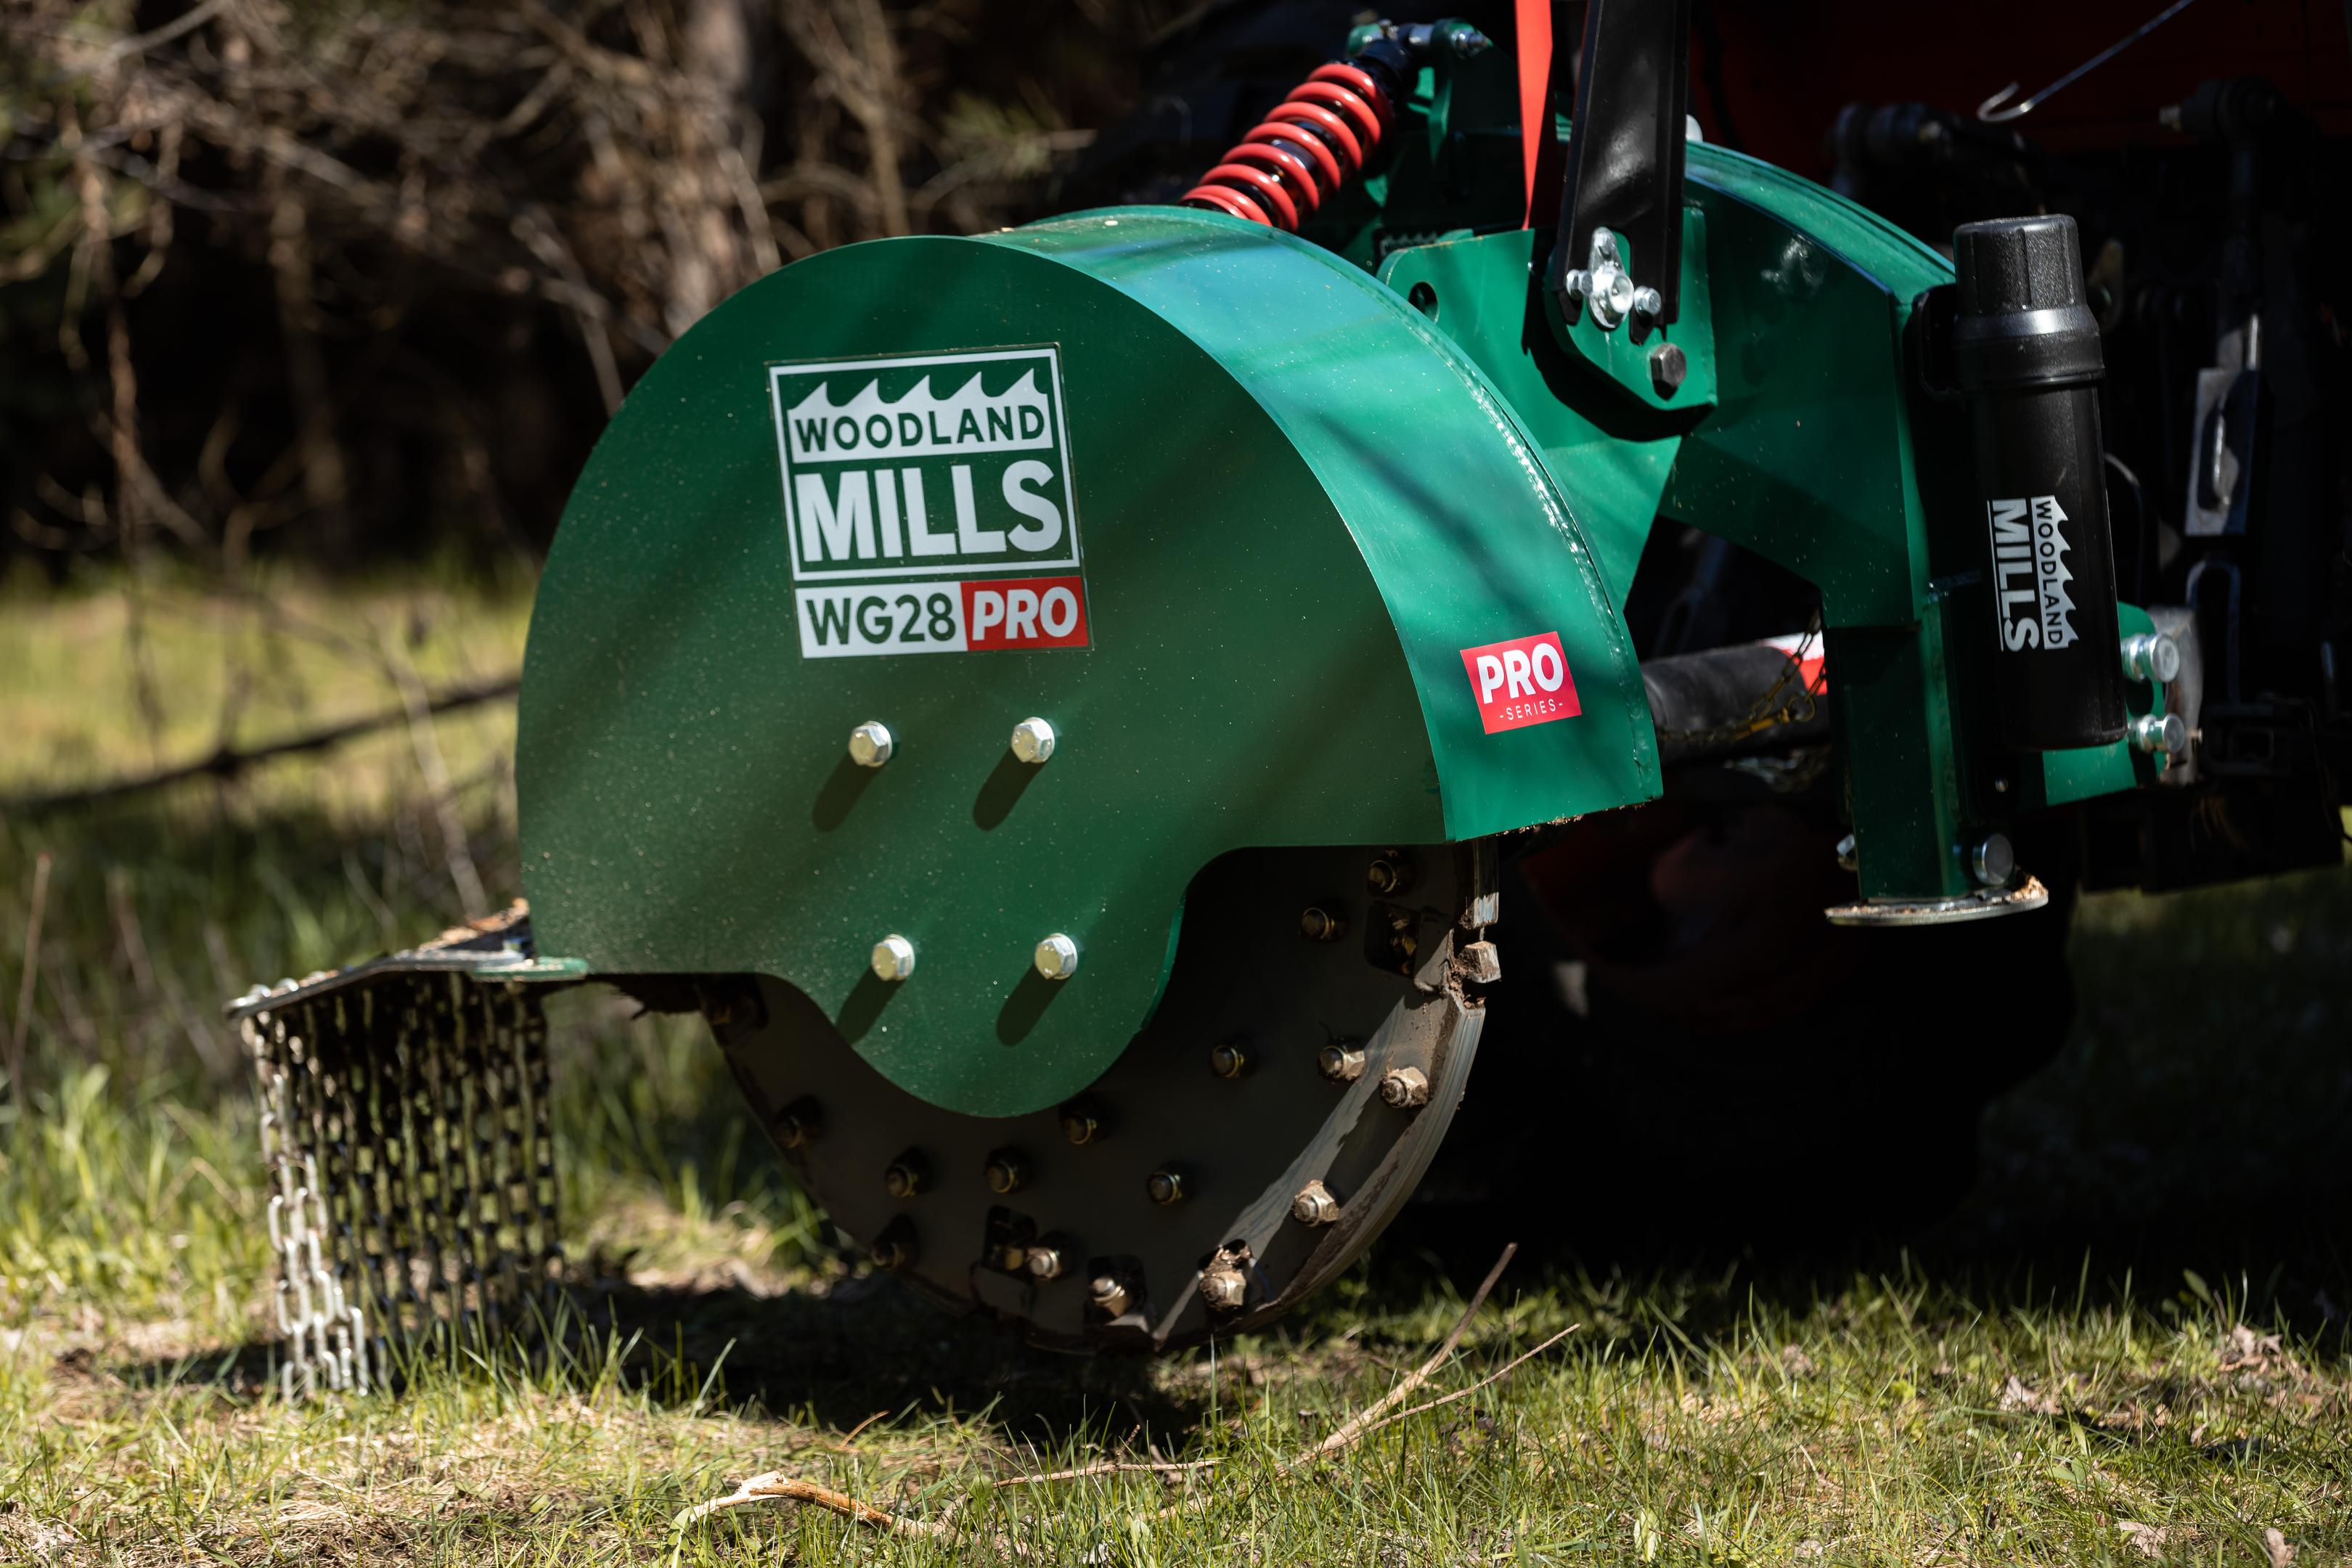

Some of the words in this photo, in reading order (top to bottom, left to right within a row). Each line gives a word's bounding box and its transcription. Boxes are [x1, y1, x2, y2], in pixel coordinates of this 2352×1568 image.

[796, 404, 1045, 452] WOODLAND
[794, 459, 1063, 562] MILLS
[1992, 498, 2040, 652] MILLS
[2035, 500, 2064, 645] WOODLAND
[805, 592, 957, 646] WG28
[971, 586, 1079, 641] PRO
[1476, 642, 1564, 705] PRO
